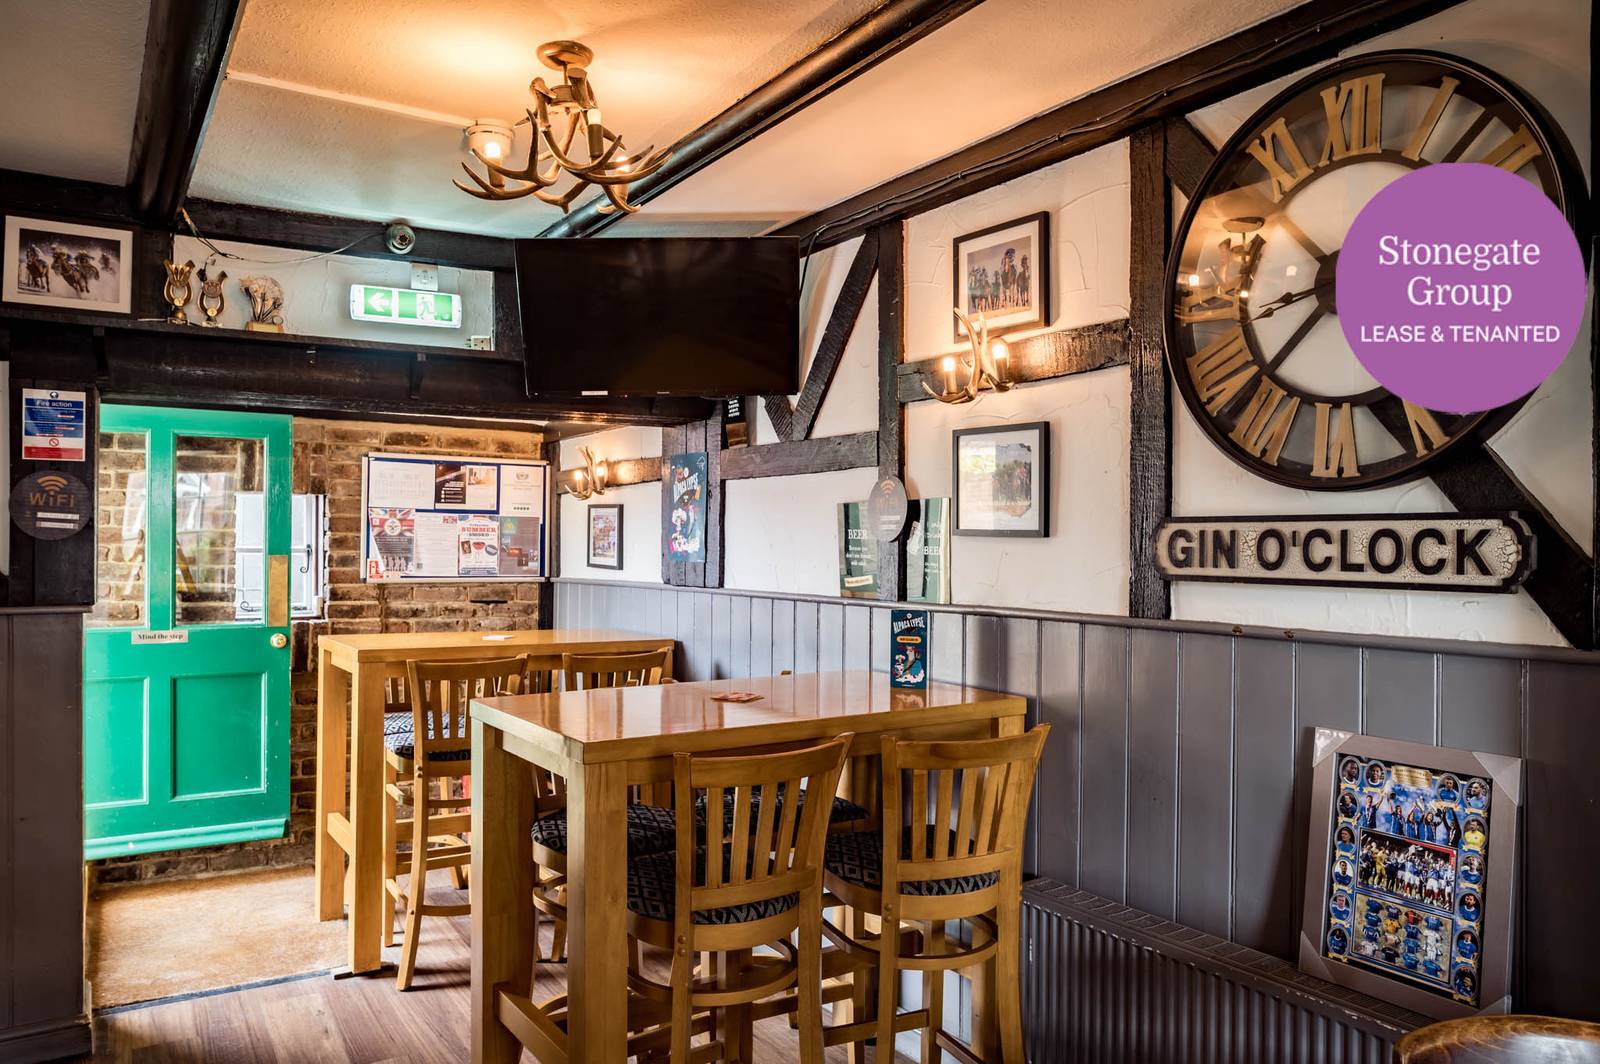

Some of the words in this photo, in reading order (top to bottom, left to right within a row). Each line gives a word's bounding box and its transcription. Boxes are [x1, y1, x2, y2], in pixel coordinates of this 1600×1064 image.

[847, 528, 868, 540] BEER
[1167, 528, 1238, 569] GIN
[1255, 527, 1497, 576] O'CLOCK
[136, 633, 157, 641] Mind
